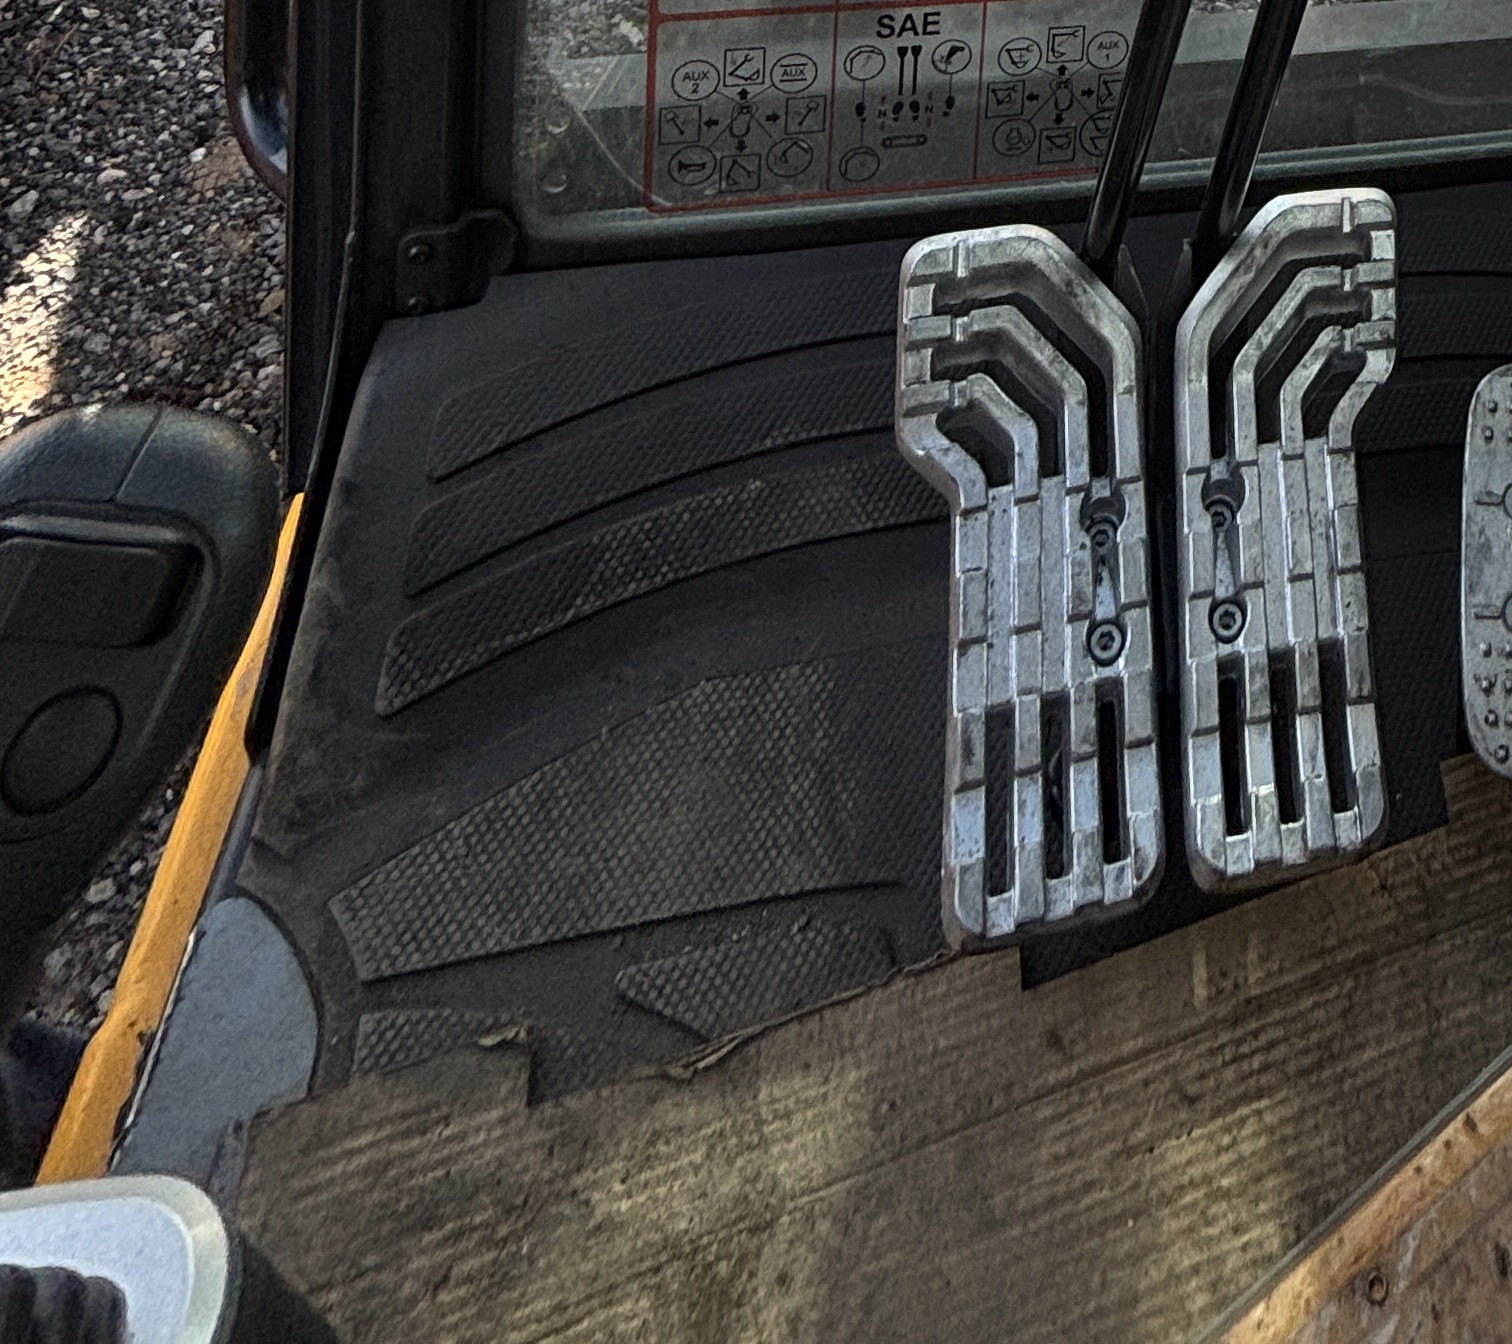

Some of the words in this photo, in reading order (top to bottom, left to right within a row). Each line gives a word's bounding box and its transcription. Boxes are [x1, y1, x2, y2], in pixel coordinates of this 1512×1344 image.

[876, 11, 941, 38] SAE
[1098, 40, 1121, 50] AUX
[1105, 52, 1111, 62] 1
[682, 70, 710, 82] AUX
[781, 66, 807, 78] AUX
[690, 83, 700, 94] 2
[925, 104, 934, 114] N
